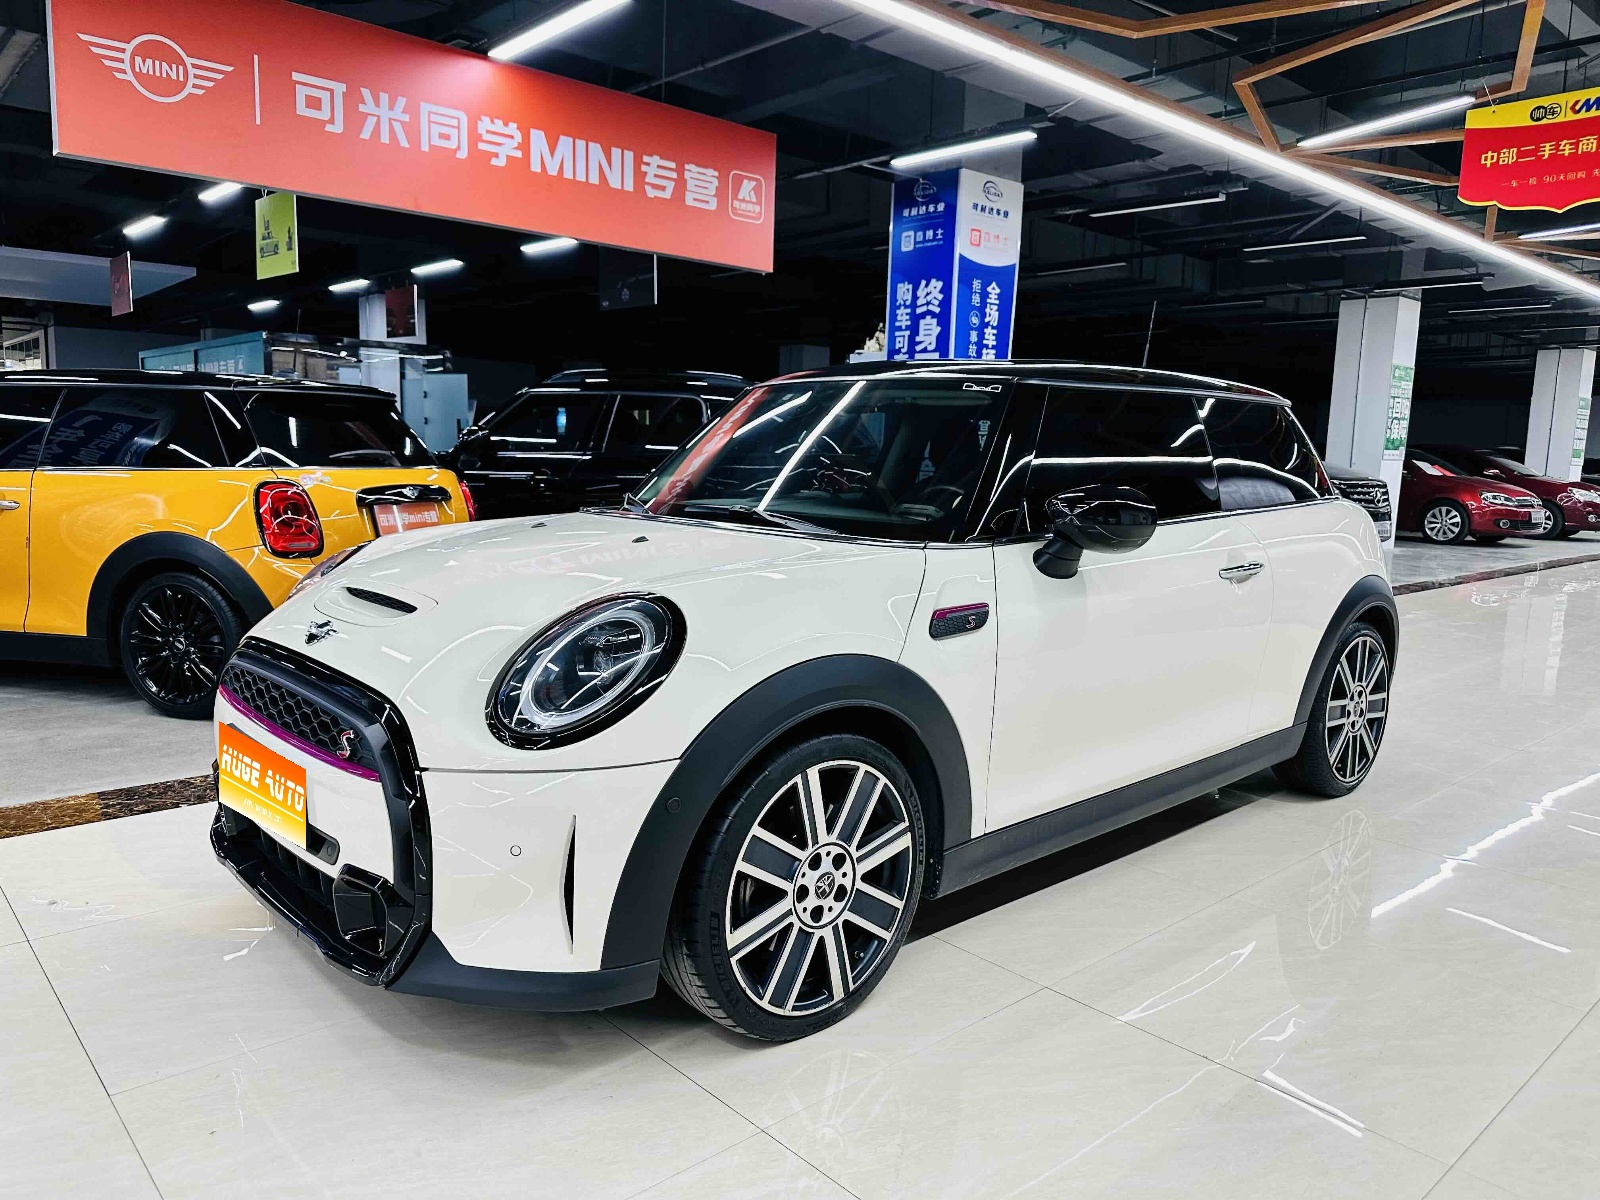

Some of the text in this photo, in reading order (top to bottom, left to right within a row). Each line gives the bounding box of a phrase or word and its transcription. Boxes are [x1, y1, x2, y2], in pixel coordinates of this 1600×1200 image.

[134, 55, 185, 82] MINI
[1480, 135, 1600, 168] 中部二手车商
[894, 281, 913, 360] 购车可
[914, 278, 944, 360] 终身
[337, 730, 354, 758] S
